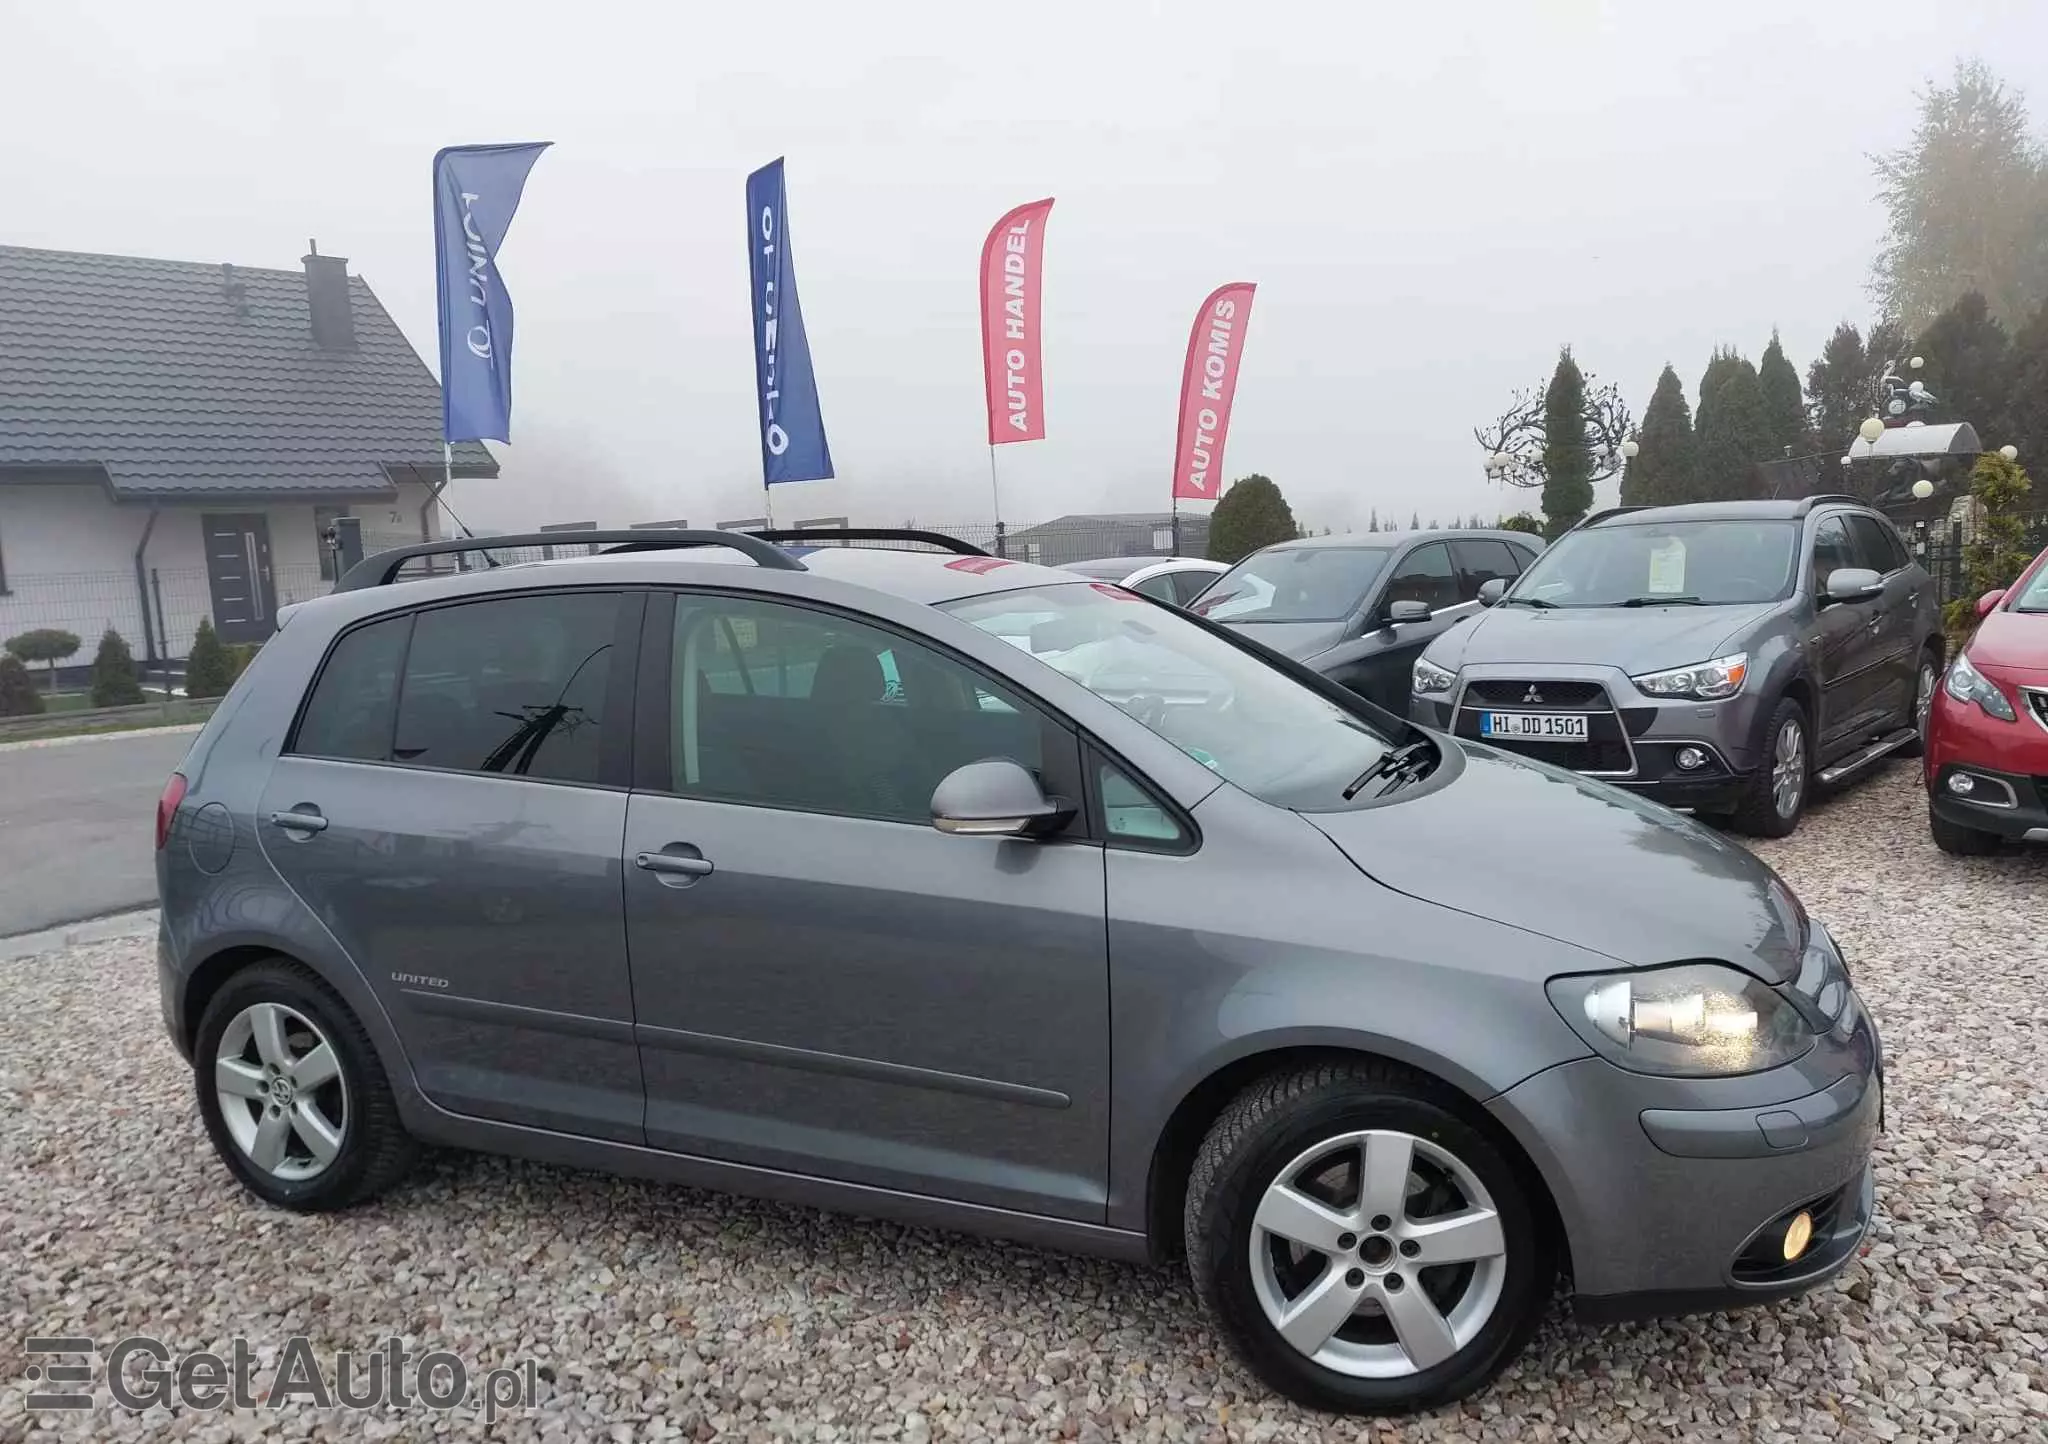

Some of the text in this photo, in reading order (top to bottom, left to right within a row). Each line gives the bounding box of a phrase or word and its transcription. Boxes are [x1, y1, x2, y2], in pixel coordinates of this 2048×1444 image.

[1004, 219, 1031, 433] AUTO HANDEL
[1189, 298, 1236, 492] AUTO KOMIS
[1493, 716, 1585, 735] HI DD 1501
[391, 971, 449, 988] UNITED
